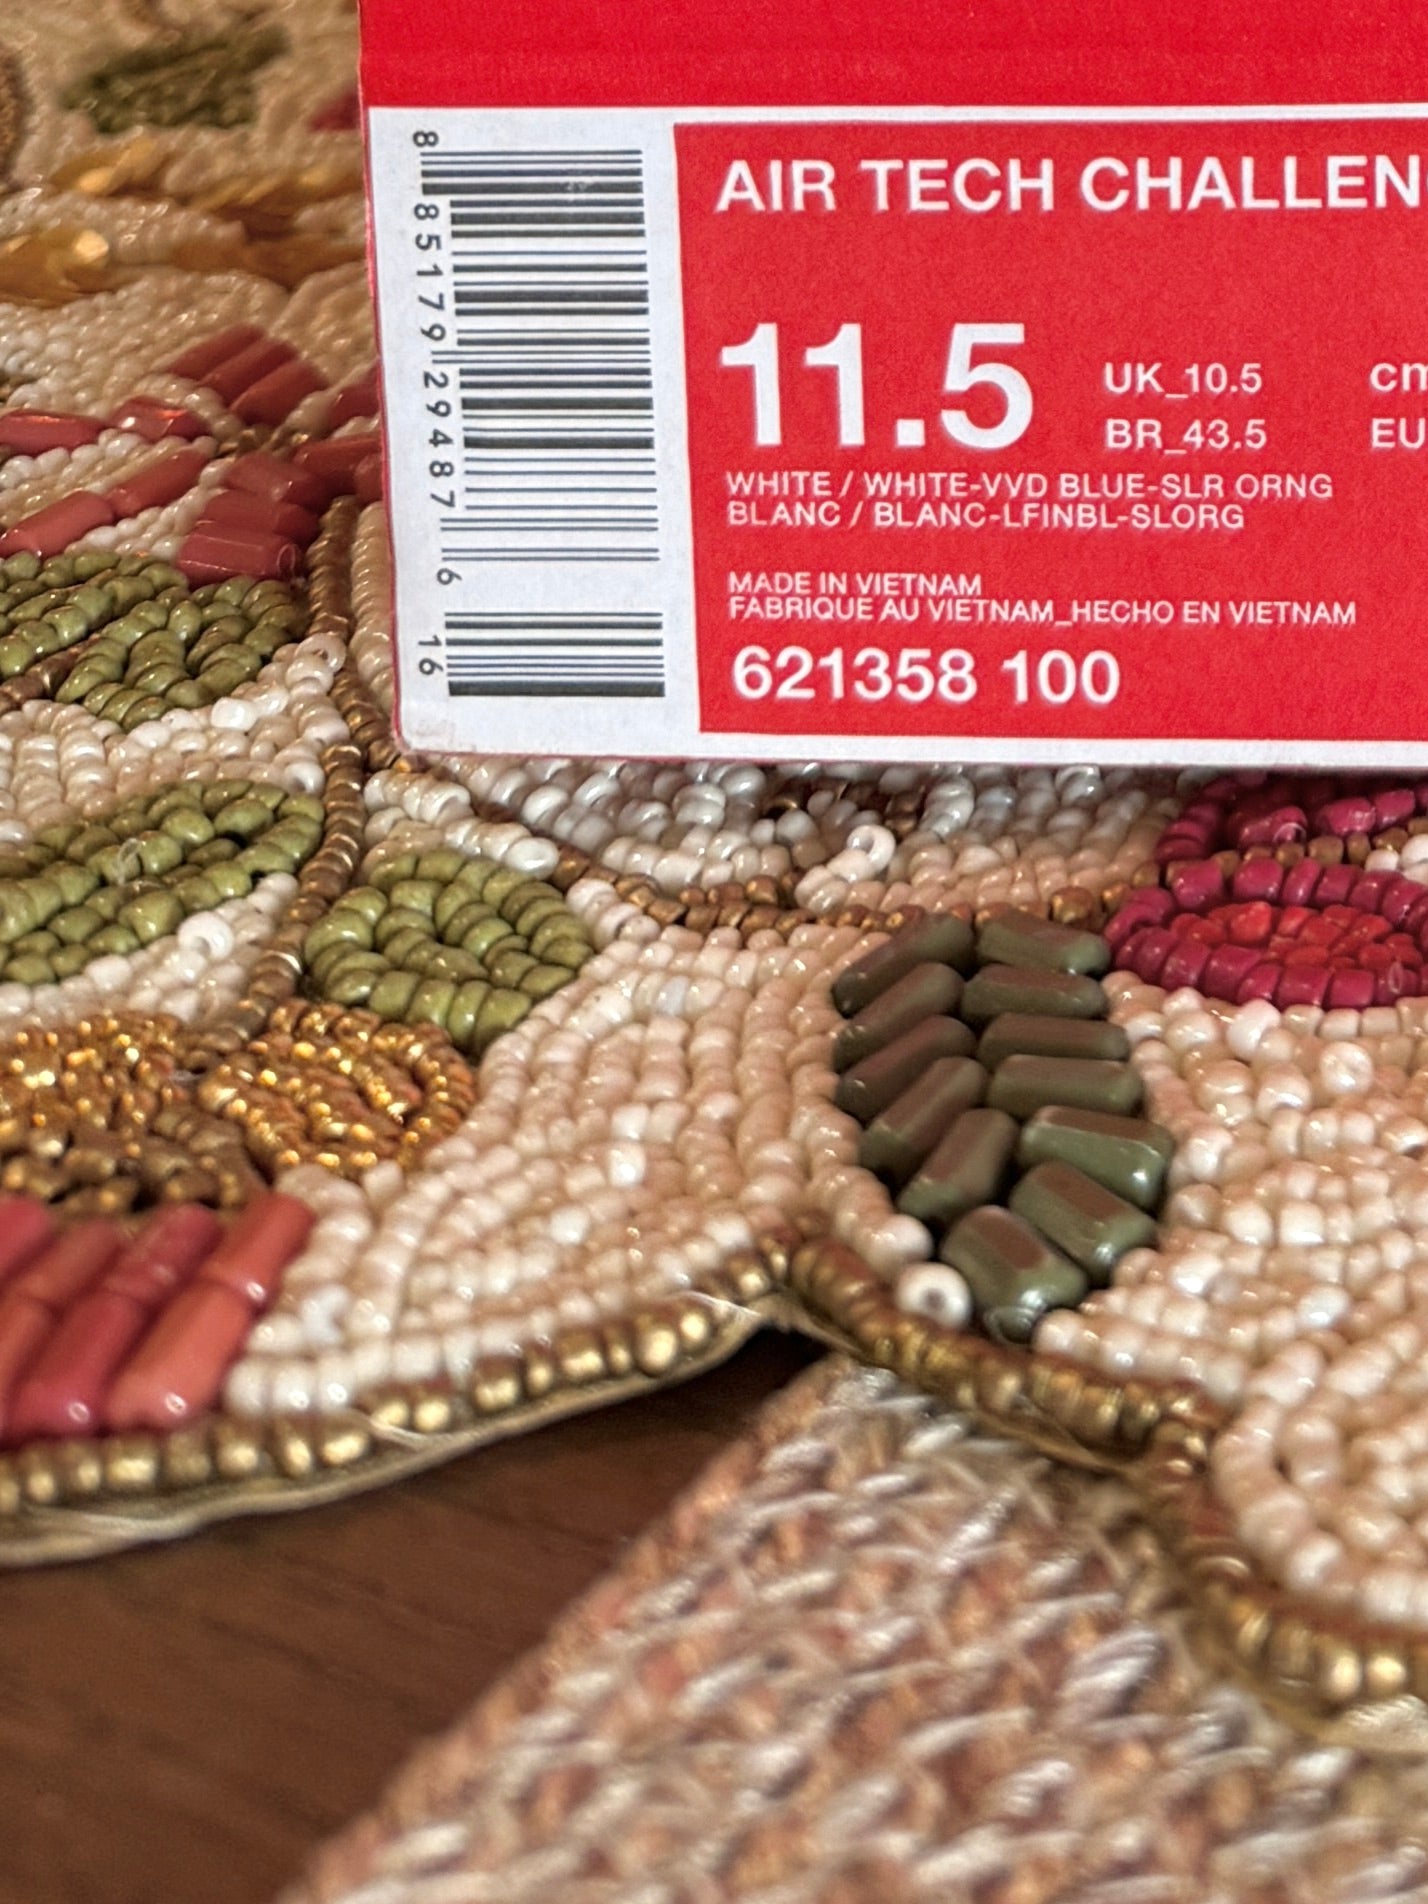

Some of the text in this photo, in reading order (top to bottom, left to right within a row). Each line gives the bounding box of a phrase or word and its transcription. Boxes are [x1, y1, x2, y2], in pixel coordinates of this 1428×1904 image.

[715, 159, 838, 213] AIR
[859, 157, 1054, 213] TECH
[719, 322, 1034, 451] 11.5
[1103, 362, 1263, 400] UK_10.5
[411, 130, 463, 677] 8 85179 29487 6 16
[1105, 418, 1267, 455] BR_43.5
[725, 471, 832, 497] WHITE
[863, 471, 1048, 499] WHITE-VVD
[1059, 472, 1224, 501] BLUE-SLR
[1234, 473, 1333, 500] ORNG
[727, 500, 841, 528] BLANC
[873, 501, 1244, 531] BLANC-LFINBL-SLORG
[728, 571, 982, 597] MADE IN VIETNAM
[728, 595, 1356, 627] FABRIQUE AU VIETNAM_HECHO EN VIETNAM
[731, 644, 1121, 706] 621358 100
